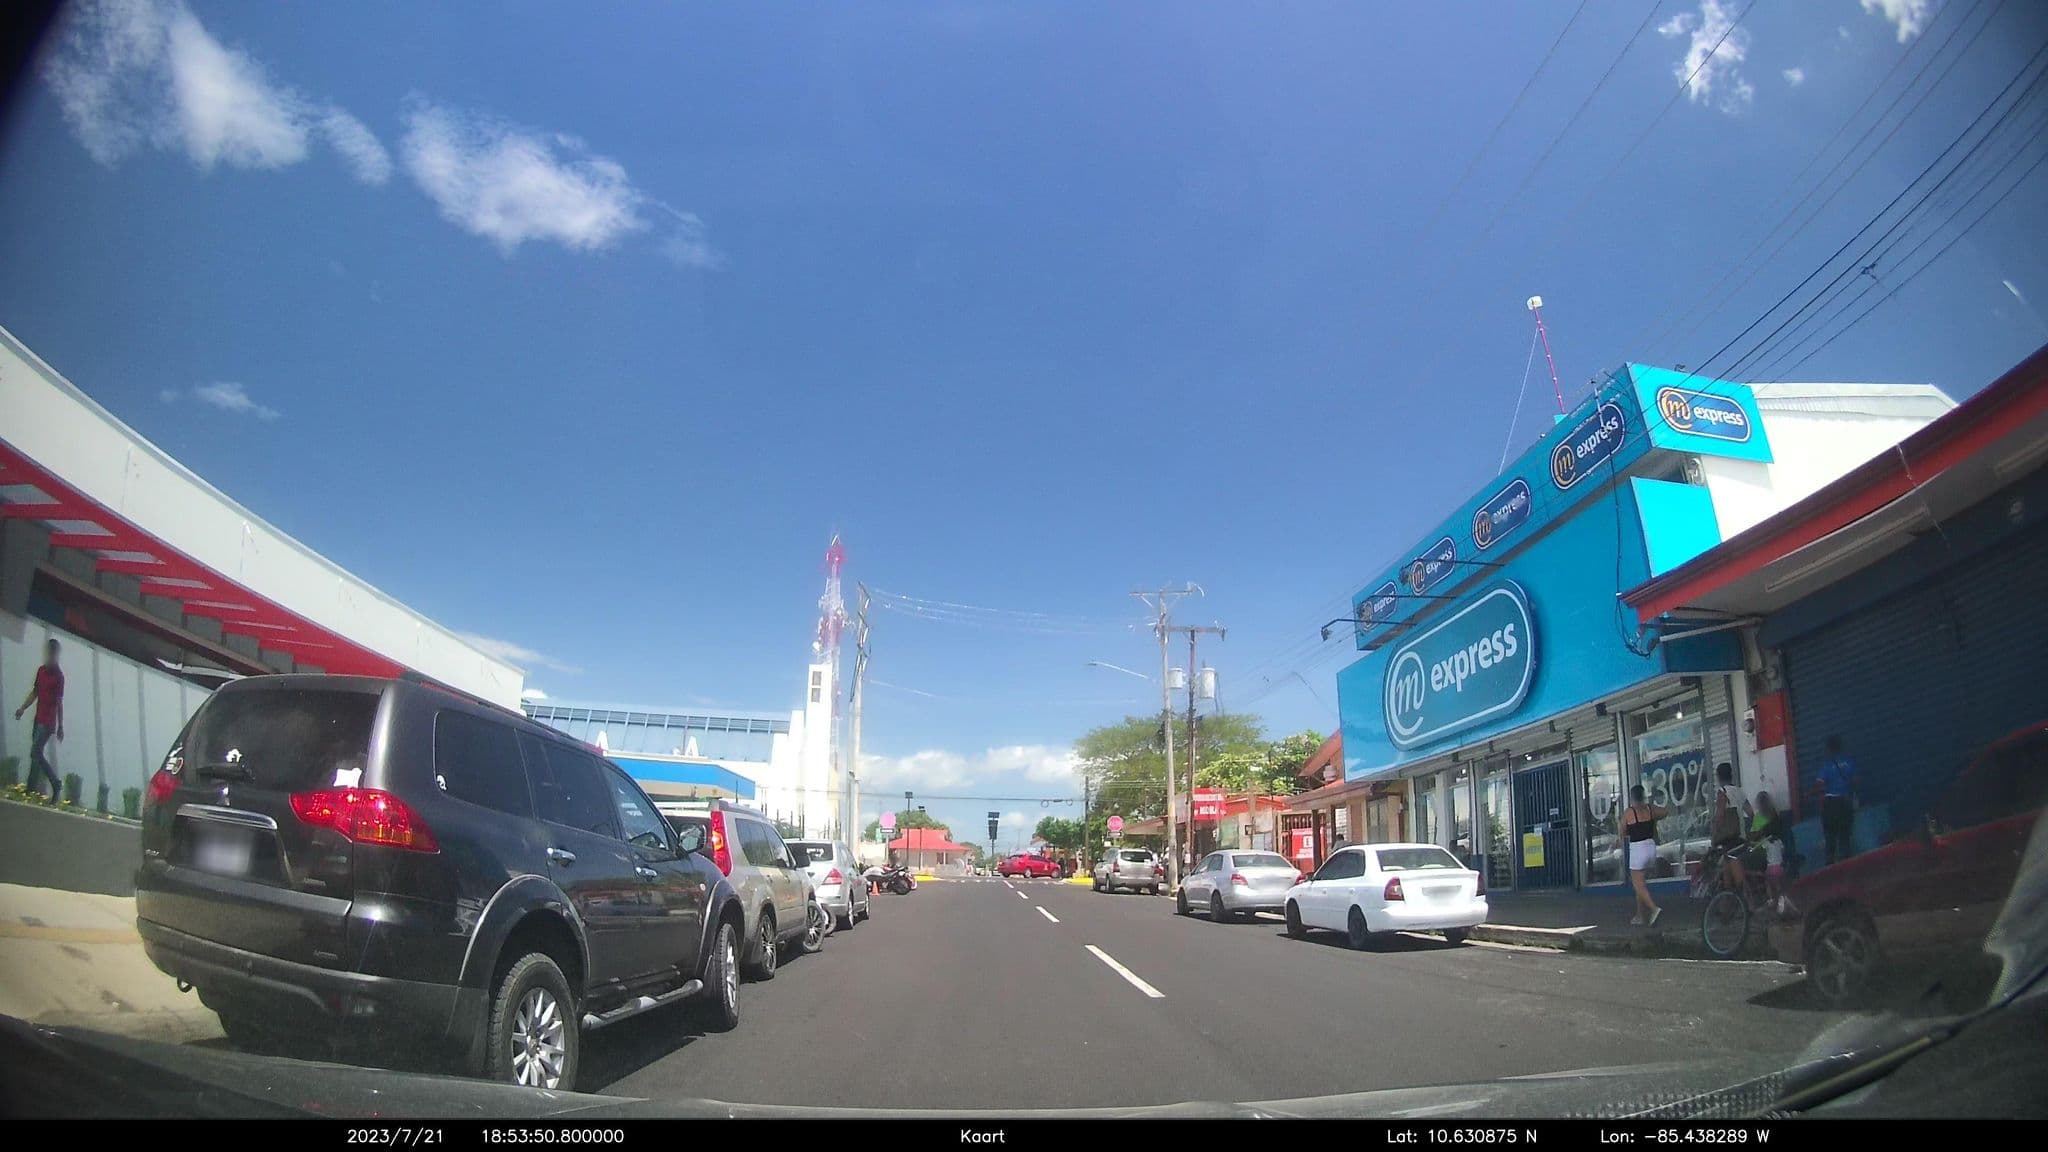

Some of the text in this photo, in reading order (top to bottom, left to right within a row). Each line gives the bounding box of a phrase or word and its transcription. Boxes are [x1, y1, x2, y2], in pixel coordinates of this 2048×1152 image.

[1576, 415, 1619, 458] express
[1693, 406, 1744, 425] express
[1430, 622, 1518, 692] express
